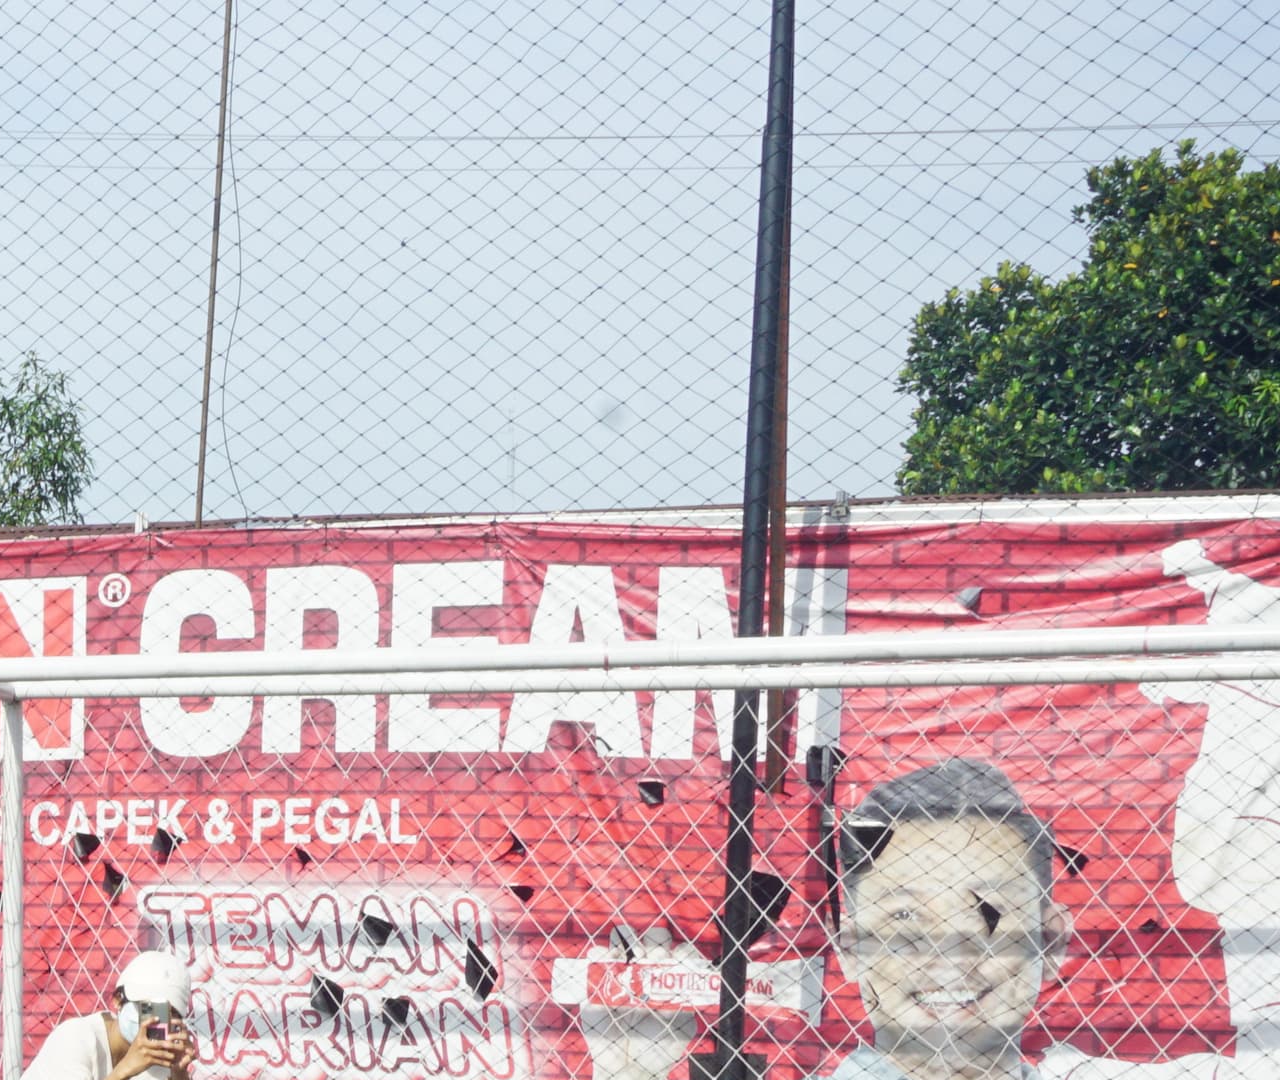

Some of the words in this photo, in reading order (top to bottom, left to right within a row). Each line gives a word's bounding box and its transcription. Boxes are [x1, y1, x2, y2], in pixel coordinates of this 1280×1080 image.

[140, 563, 846, 765] CREAM
[30, 798, 186, 847] CAPEK
[204, 799, 237, 845] &
[252, 797, 418, 846] PEGAL
[143, 892, 490, 978] TEMAN
